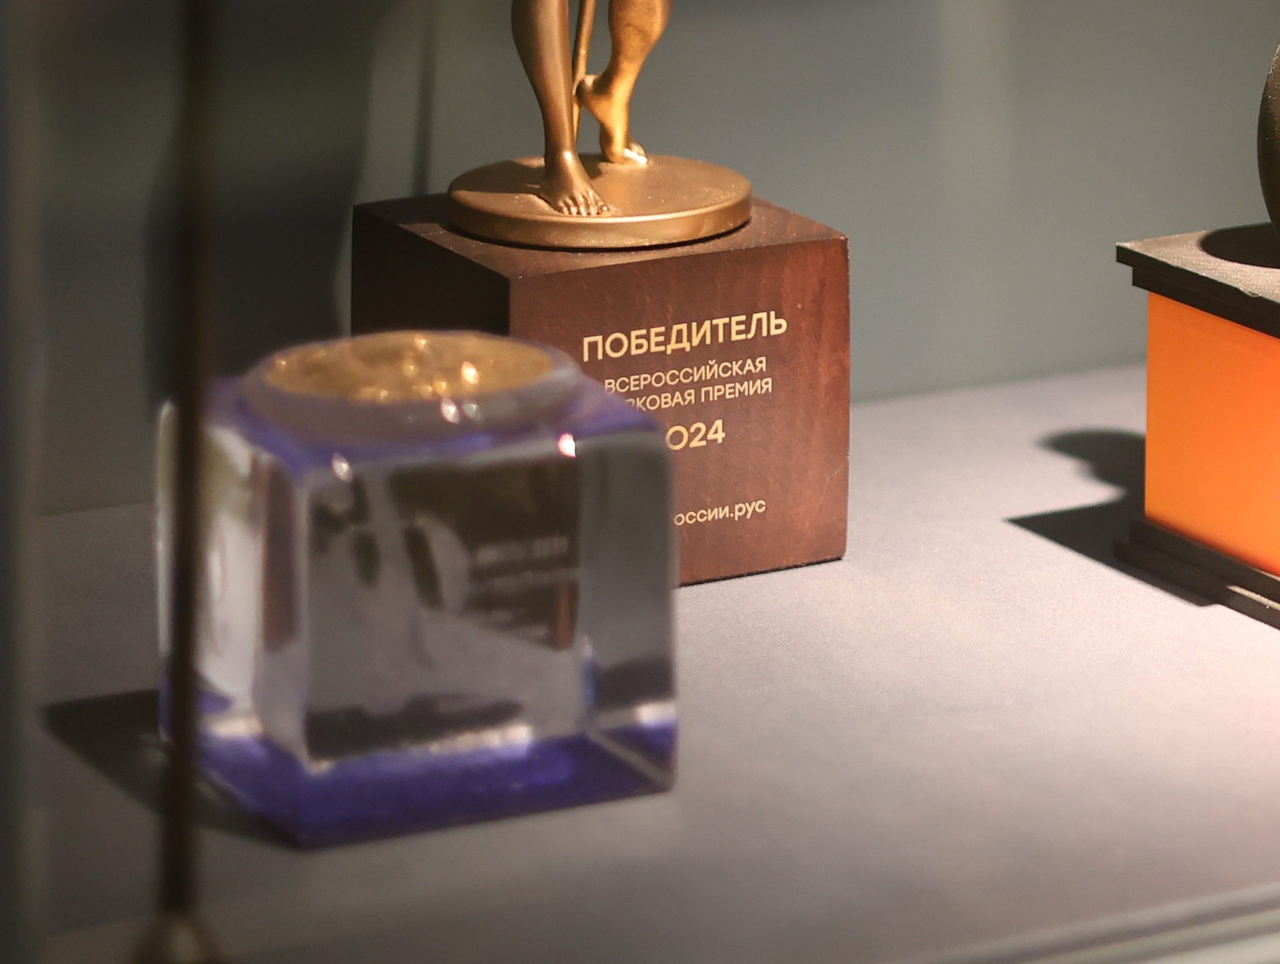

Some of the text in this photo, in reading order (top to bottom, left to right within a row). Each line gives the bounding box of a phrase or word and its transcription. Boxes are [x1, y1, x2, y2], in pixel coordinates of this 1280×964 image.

[583, 311, 788, 362] ПОБЕДИТЕЛЬ
[604, 356, 767, 394] ВСЕРОССИЙСКАЯ
[701, 377, 773, 403] ПРЕМИЯ
[665, 419, 726, 451] 024
[674, 499, 766, 526] оссии.рус
